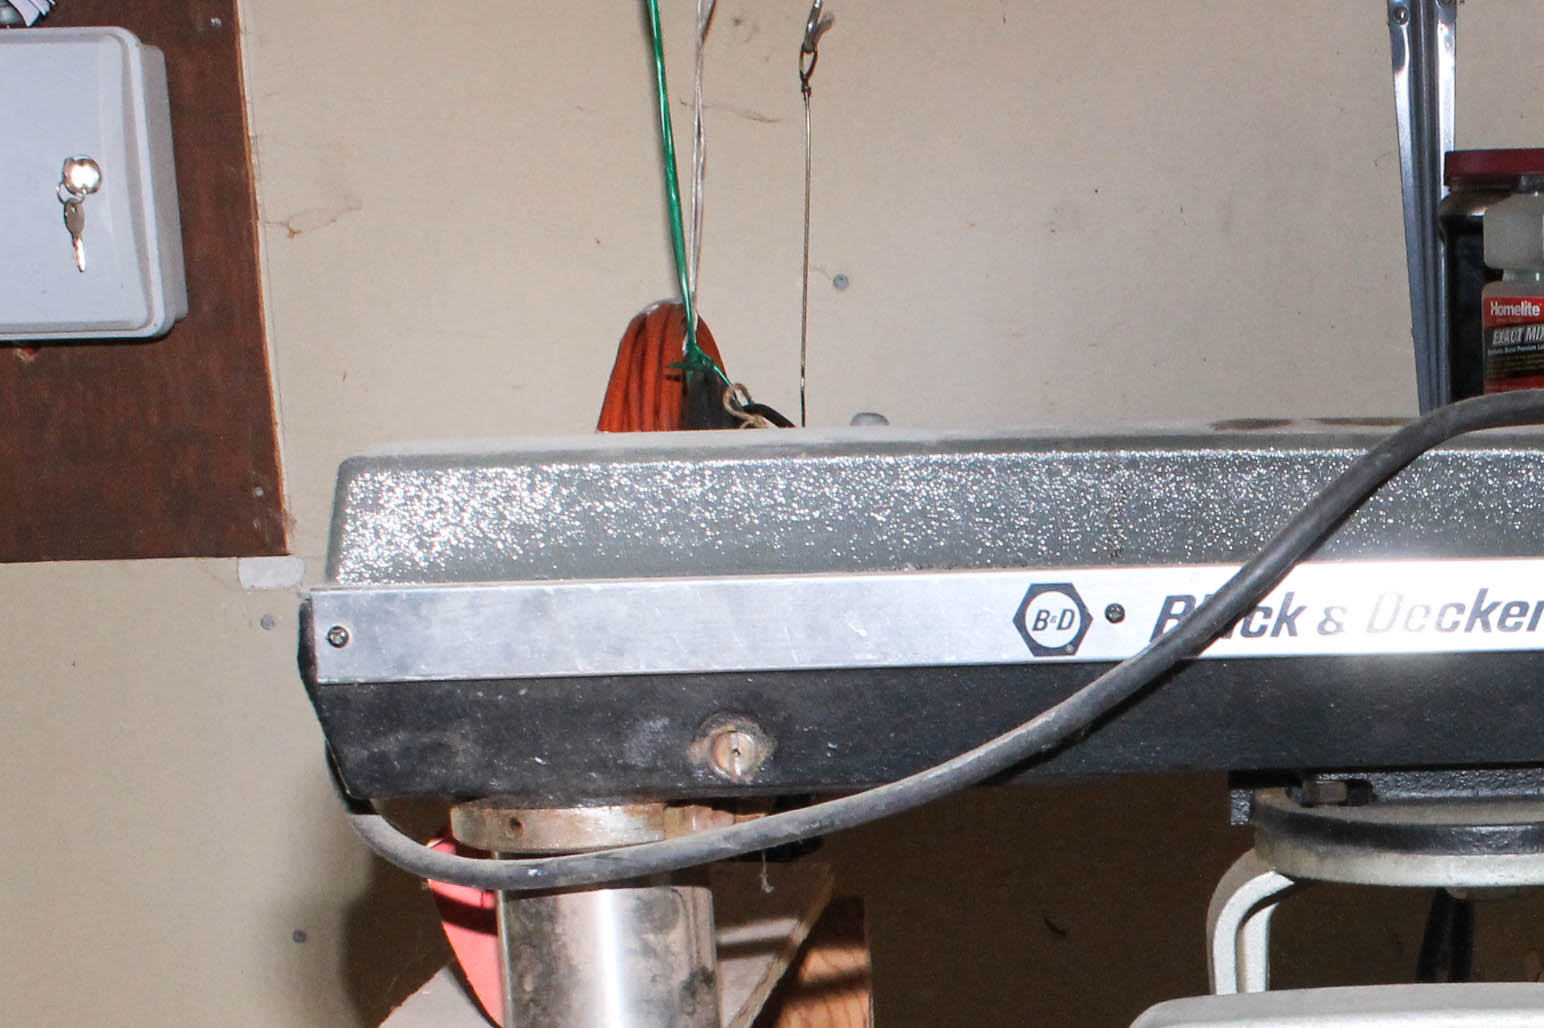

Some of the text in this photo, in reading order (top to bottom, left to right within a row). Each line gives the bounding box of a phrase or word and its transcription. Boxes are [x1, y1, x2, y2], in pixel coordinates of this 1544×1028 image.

[1490, 301, 1541, 317] Homelite
[1493, 327, 1524, 346] EXACT
[1032, 608, 1076, 632] B&D
[1150, 591, 1307, 645] Bck
[1317, 605, 1347, 636] &
